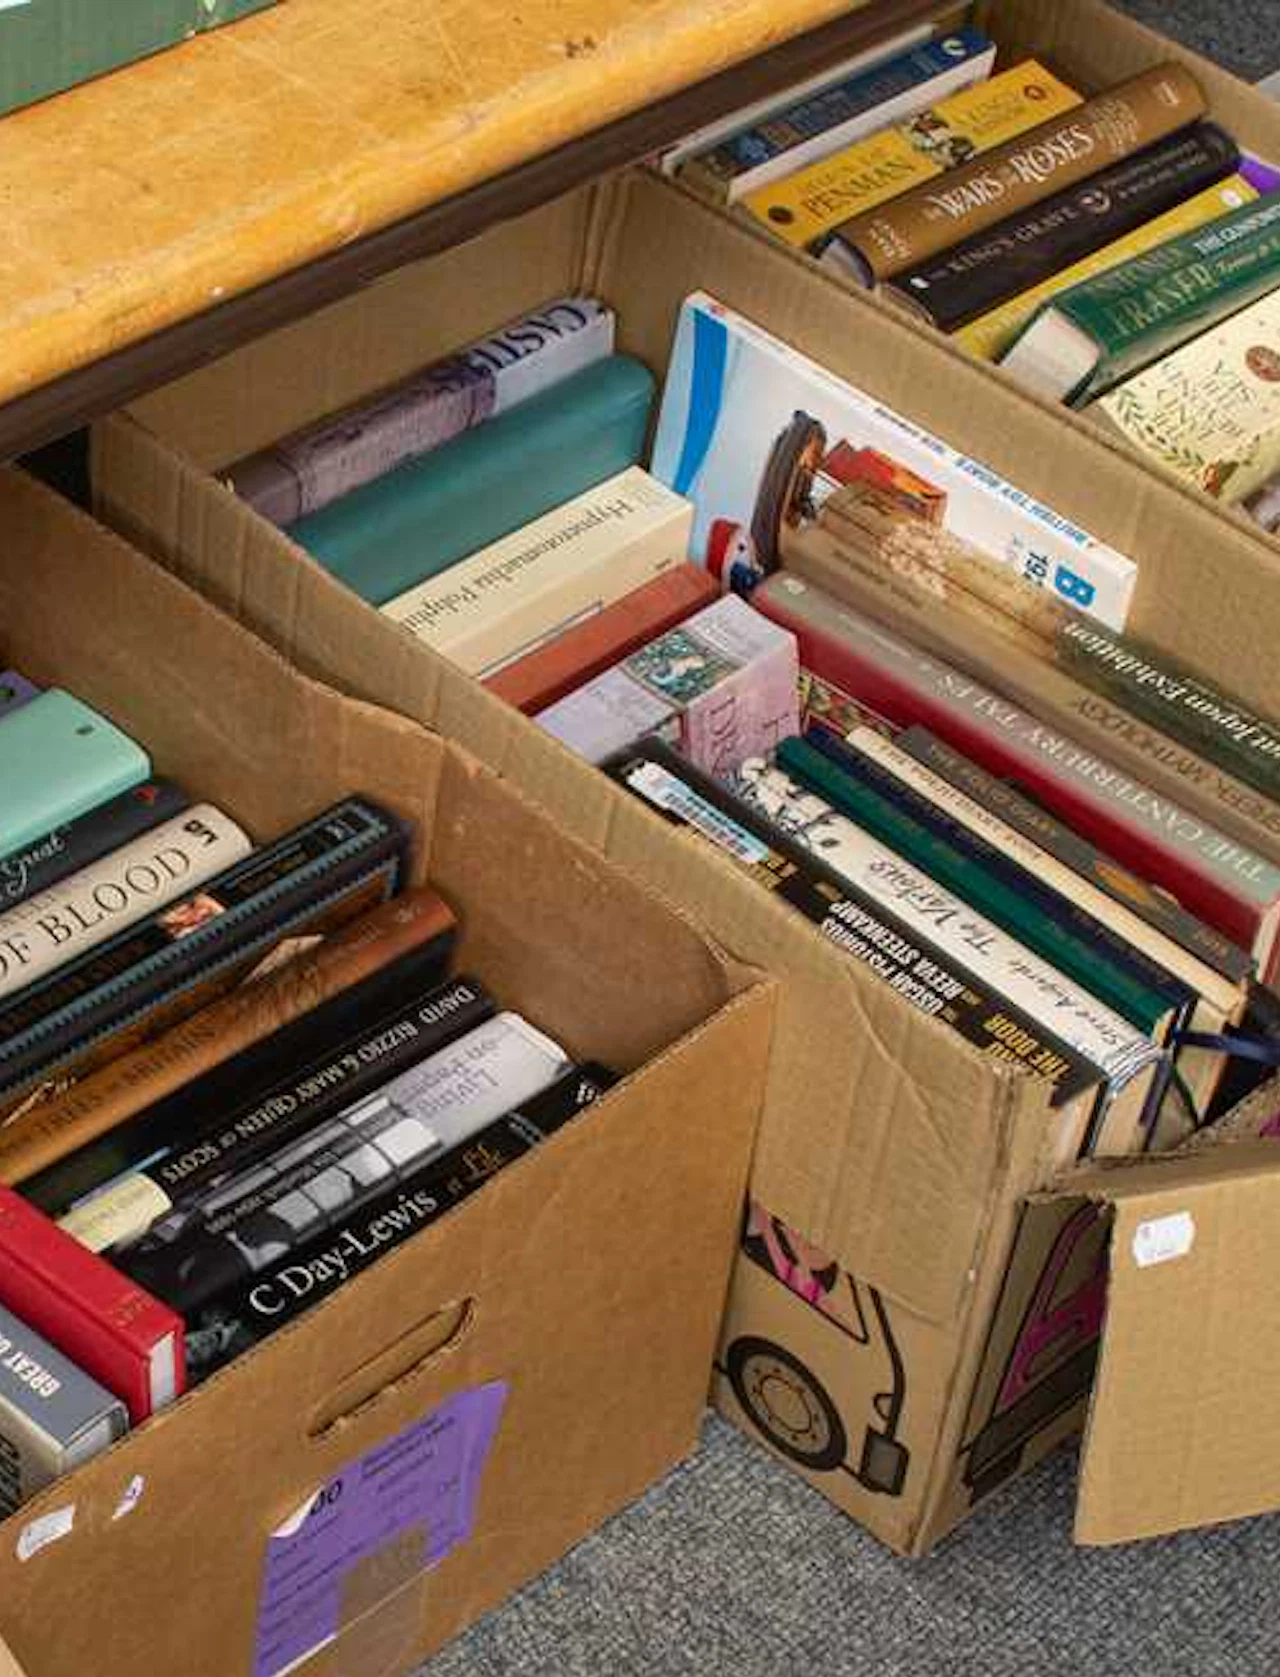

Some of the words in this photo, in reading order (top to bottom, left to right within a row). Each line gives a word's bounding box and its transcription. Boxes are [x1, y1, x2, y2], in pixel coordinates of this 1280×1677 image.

[932, 170, 1007, 221] WARS
[1010, 121, 1097, 187] ROSES
[1063, 619, 1188, 704] Exhibition
[1023, 724, 1208, 854] CANTERBURY
[36, 843, 193, 948] BLOOD
[828, 899, 922, 970] STEENKAMP
[418, 985, 479, 1030] DAVID
[914, 957, 963, 1001] REEVA
[235, 1090, 297, 1138] QUEEN
[160, 1139, 222, 1185] SCOTS
[249, 1283, 286, 1317] C
[282, 1187, 440, 1299] Day-Lewis
[0, 1343, 64, 1400] GREAT
